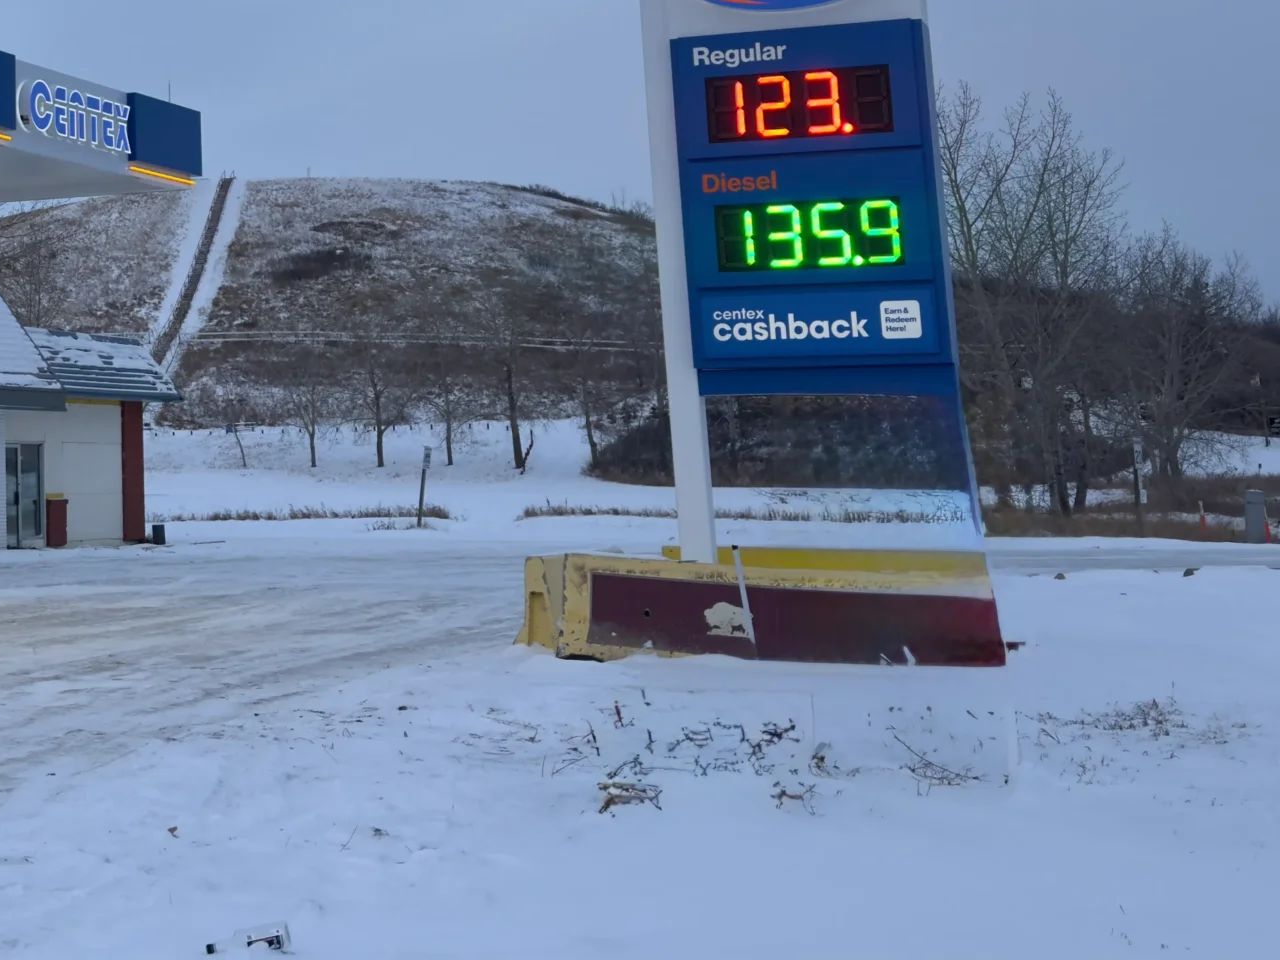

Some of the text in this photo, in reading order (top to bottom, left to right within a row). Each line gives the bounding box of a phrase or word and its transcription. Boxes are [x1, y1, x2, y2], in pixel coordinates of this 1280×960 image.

[692, 42, 787, 68] Regular
[29, 79, 132, 154] CENTEX
[701, 170, 778, 194] Diesel
[743, 199, 902, 268] 135.9
[713, 307, 765, 321] centex
[884, 307, 903, 315] Earn
[713, 311, 870, 341] cashback
[886, 324, 907, 332] Here!
